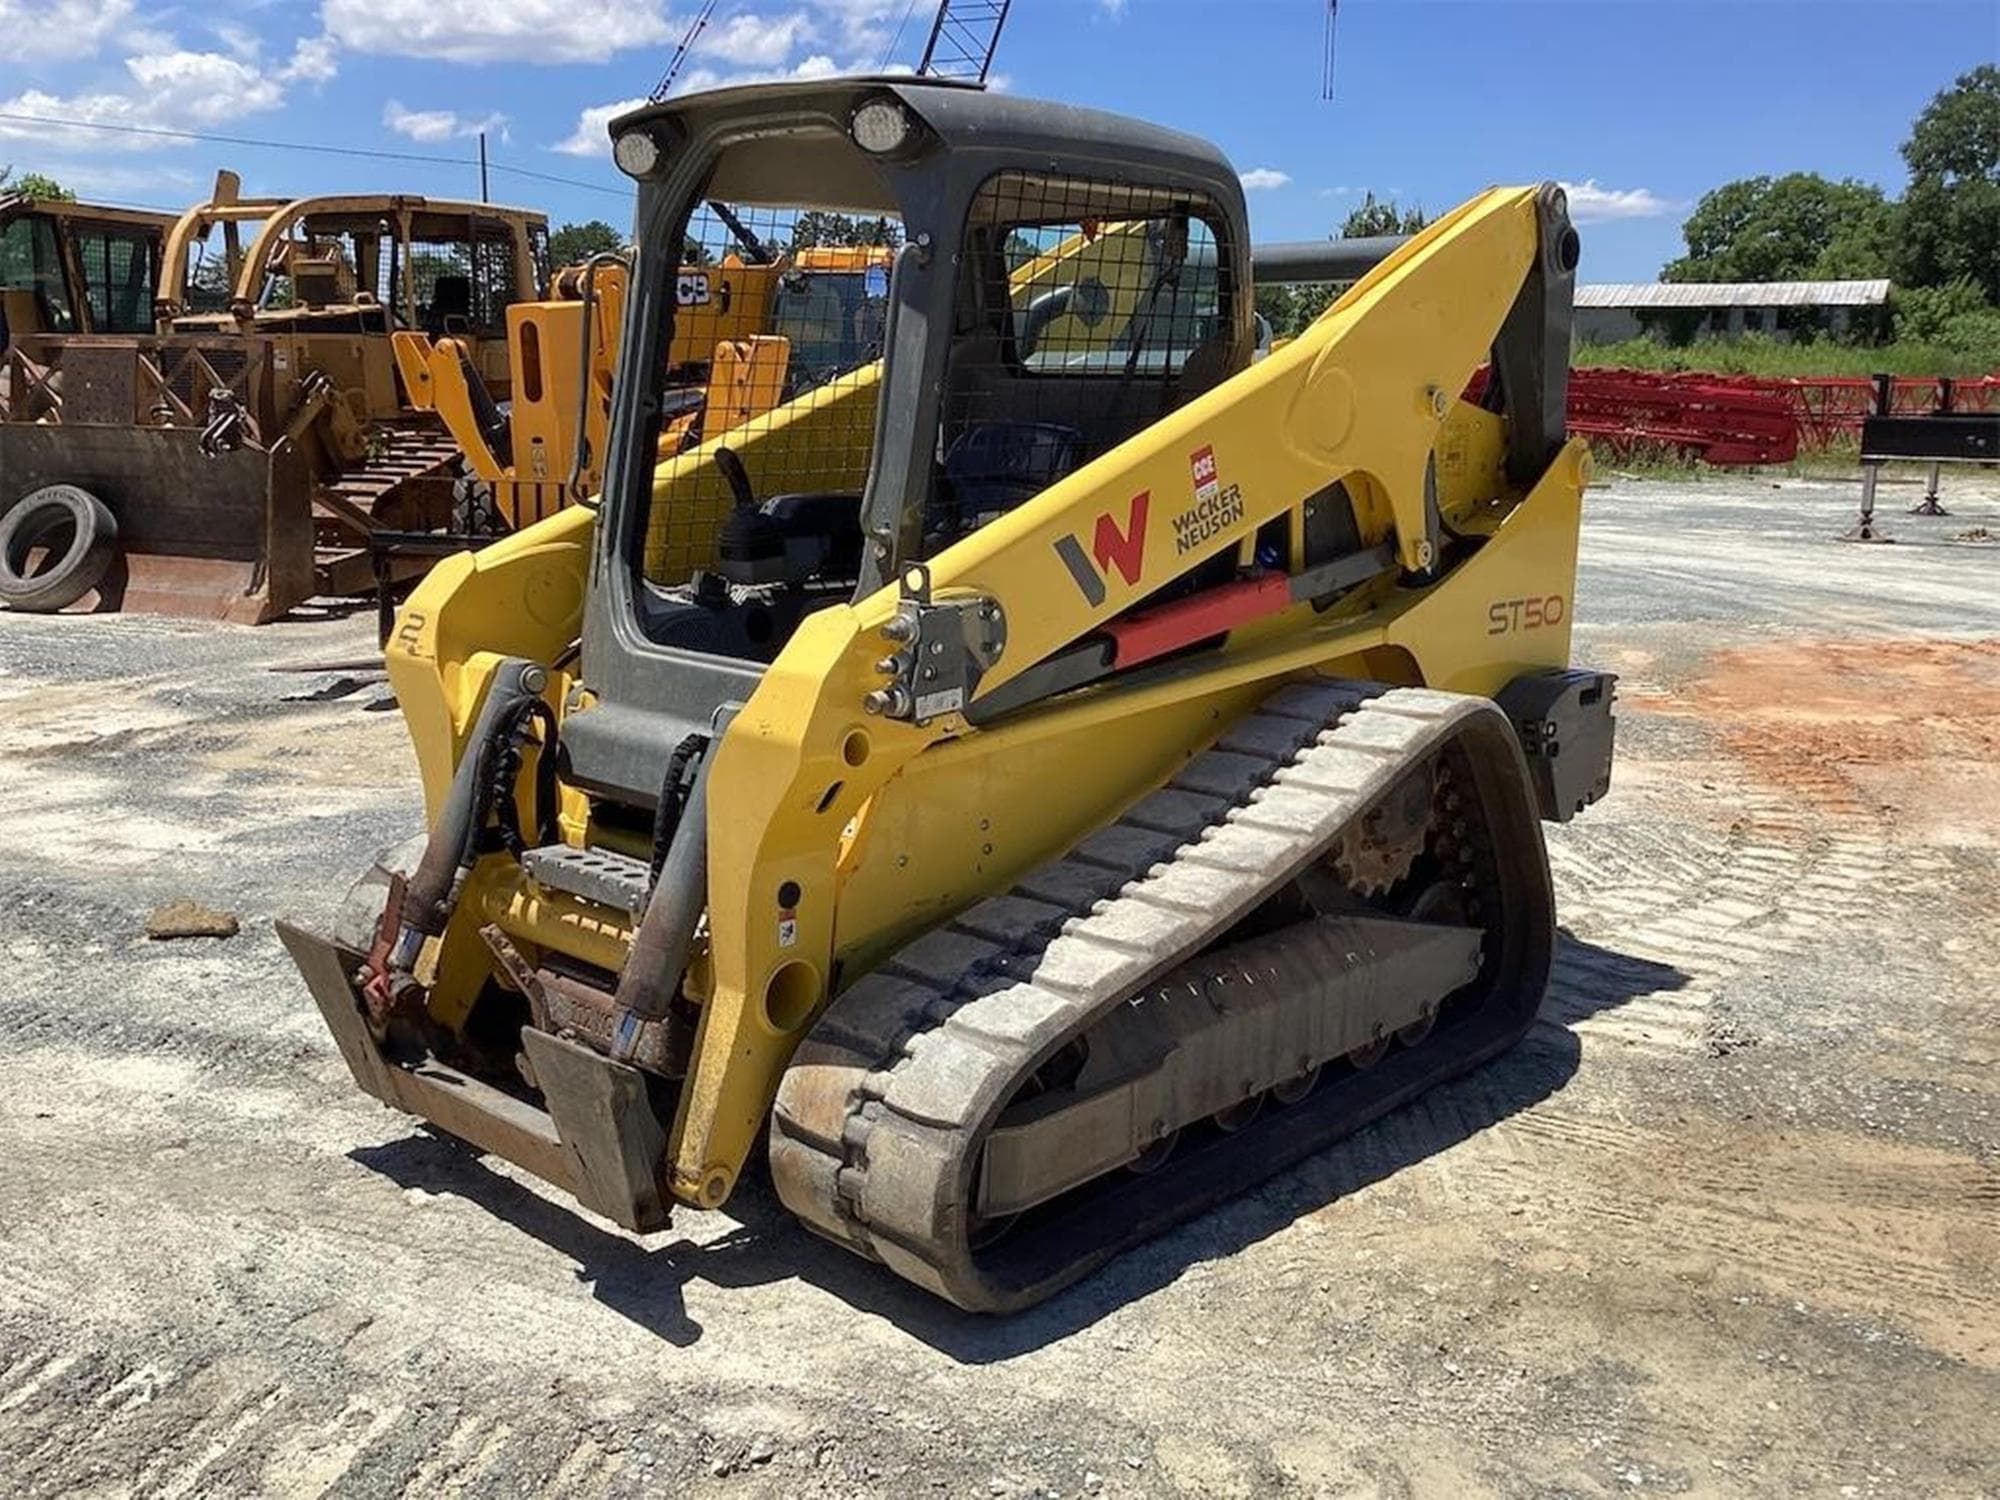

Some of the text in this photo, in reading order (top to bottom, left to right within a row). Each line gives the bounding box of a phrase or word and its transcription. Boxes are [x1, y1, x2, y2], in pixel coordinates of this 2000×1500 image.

[676, 275, 710, 304] CB
[1172, 483, 1241, 534] WACKER
[1176, 500, 1244, 555] NEUSON
[1487, 595, 1564, 635] ST50
